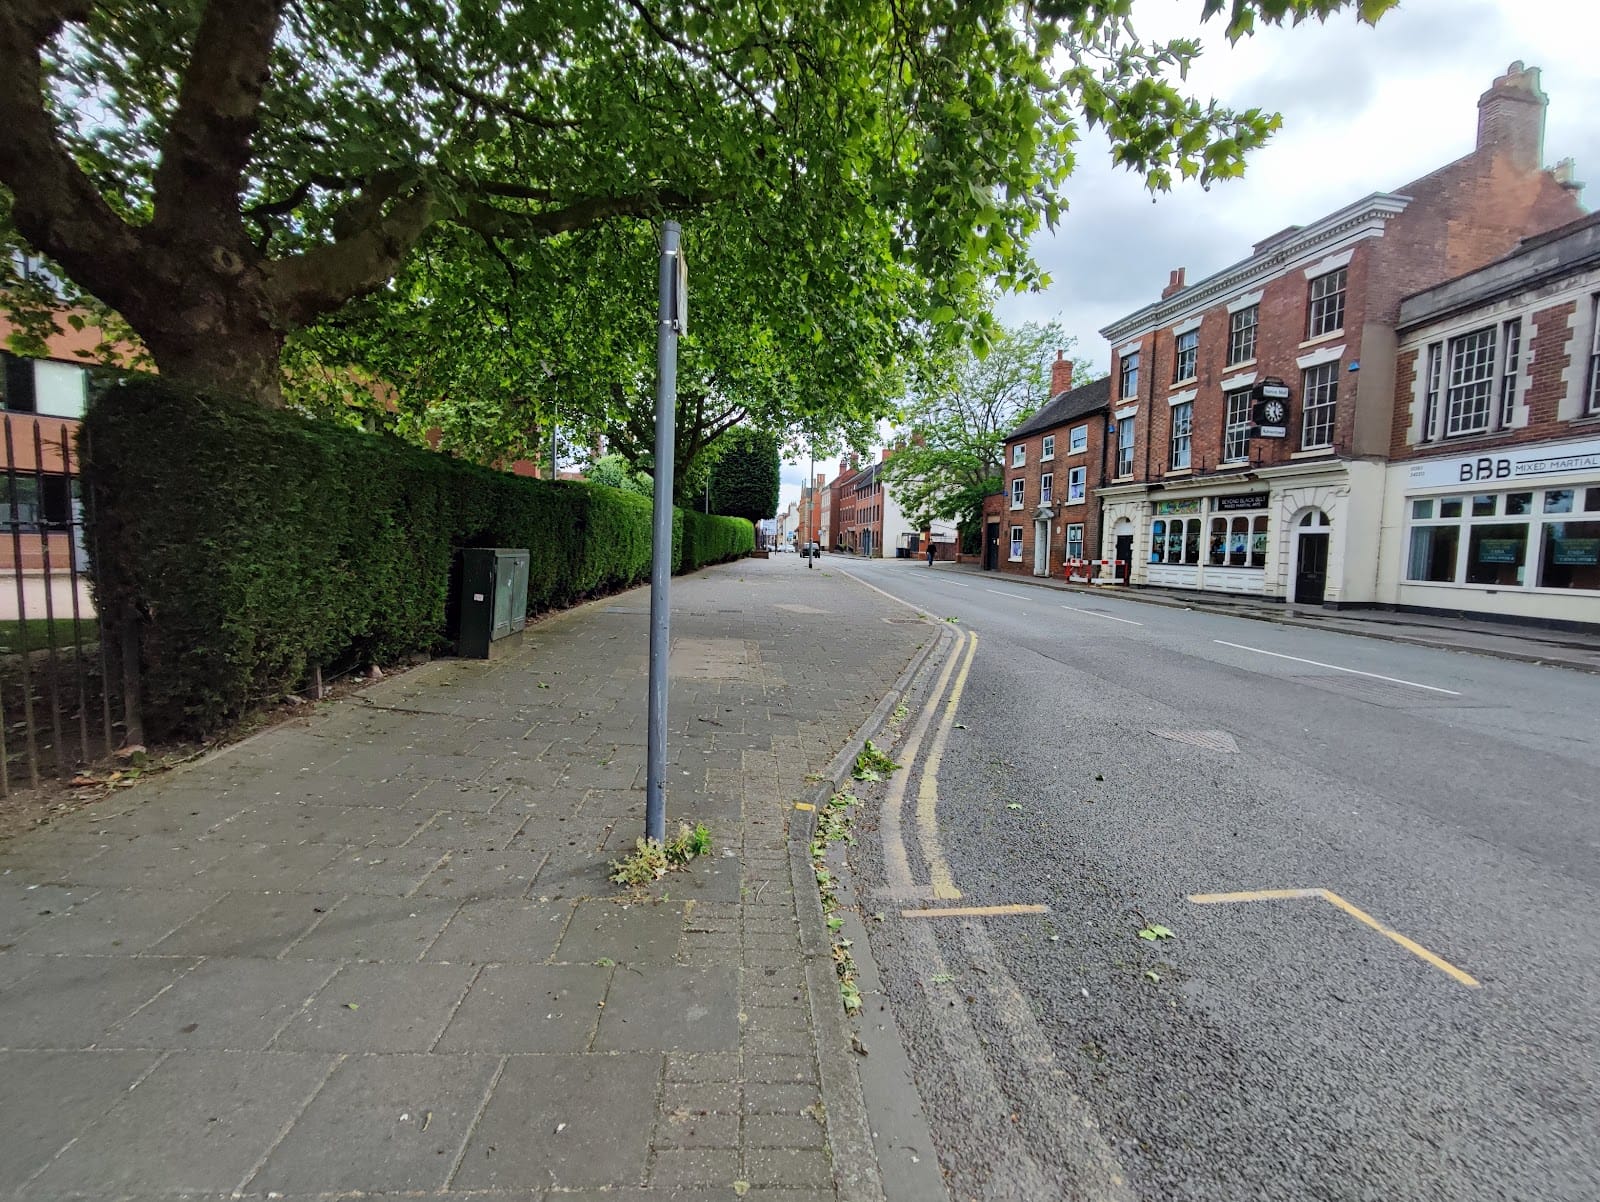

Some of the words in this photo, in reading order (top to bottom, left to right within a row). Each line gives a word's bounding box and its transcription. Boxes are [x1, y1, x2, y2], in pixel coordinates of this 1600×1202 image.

[1460, 458, 1511, 481] BBB
[1515, 462, 1546, 473] MIXED
[1549, 457, 1598, 468] MARTIAL
